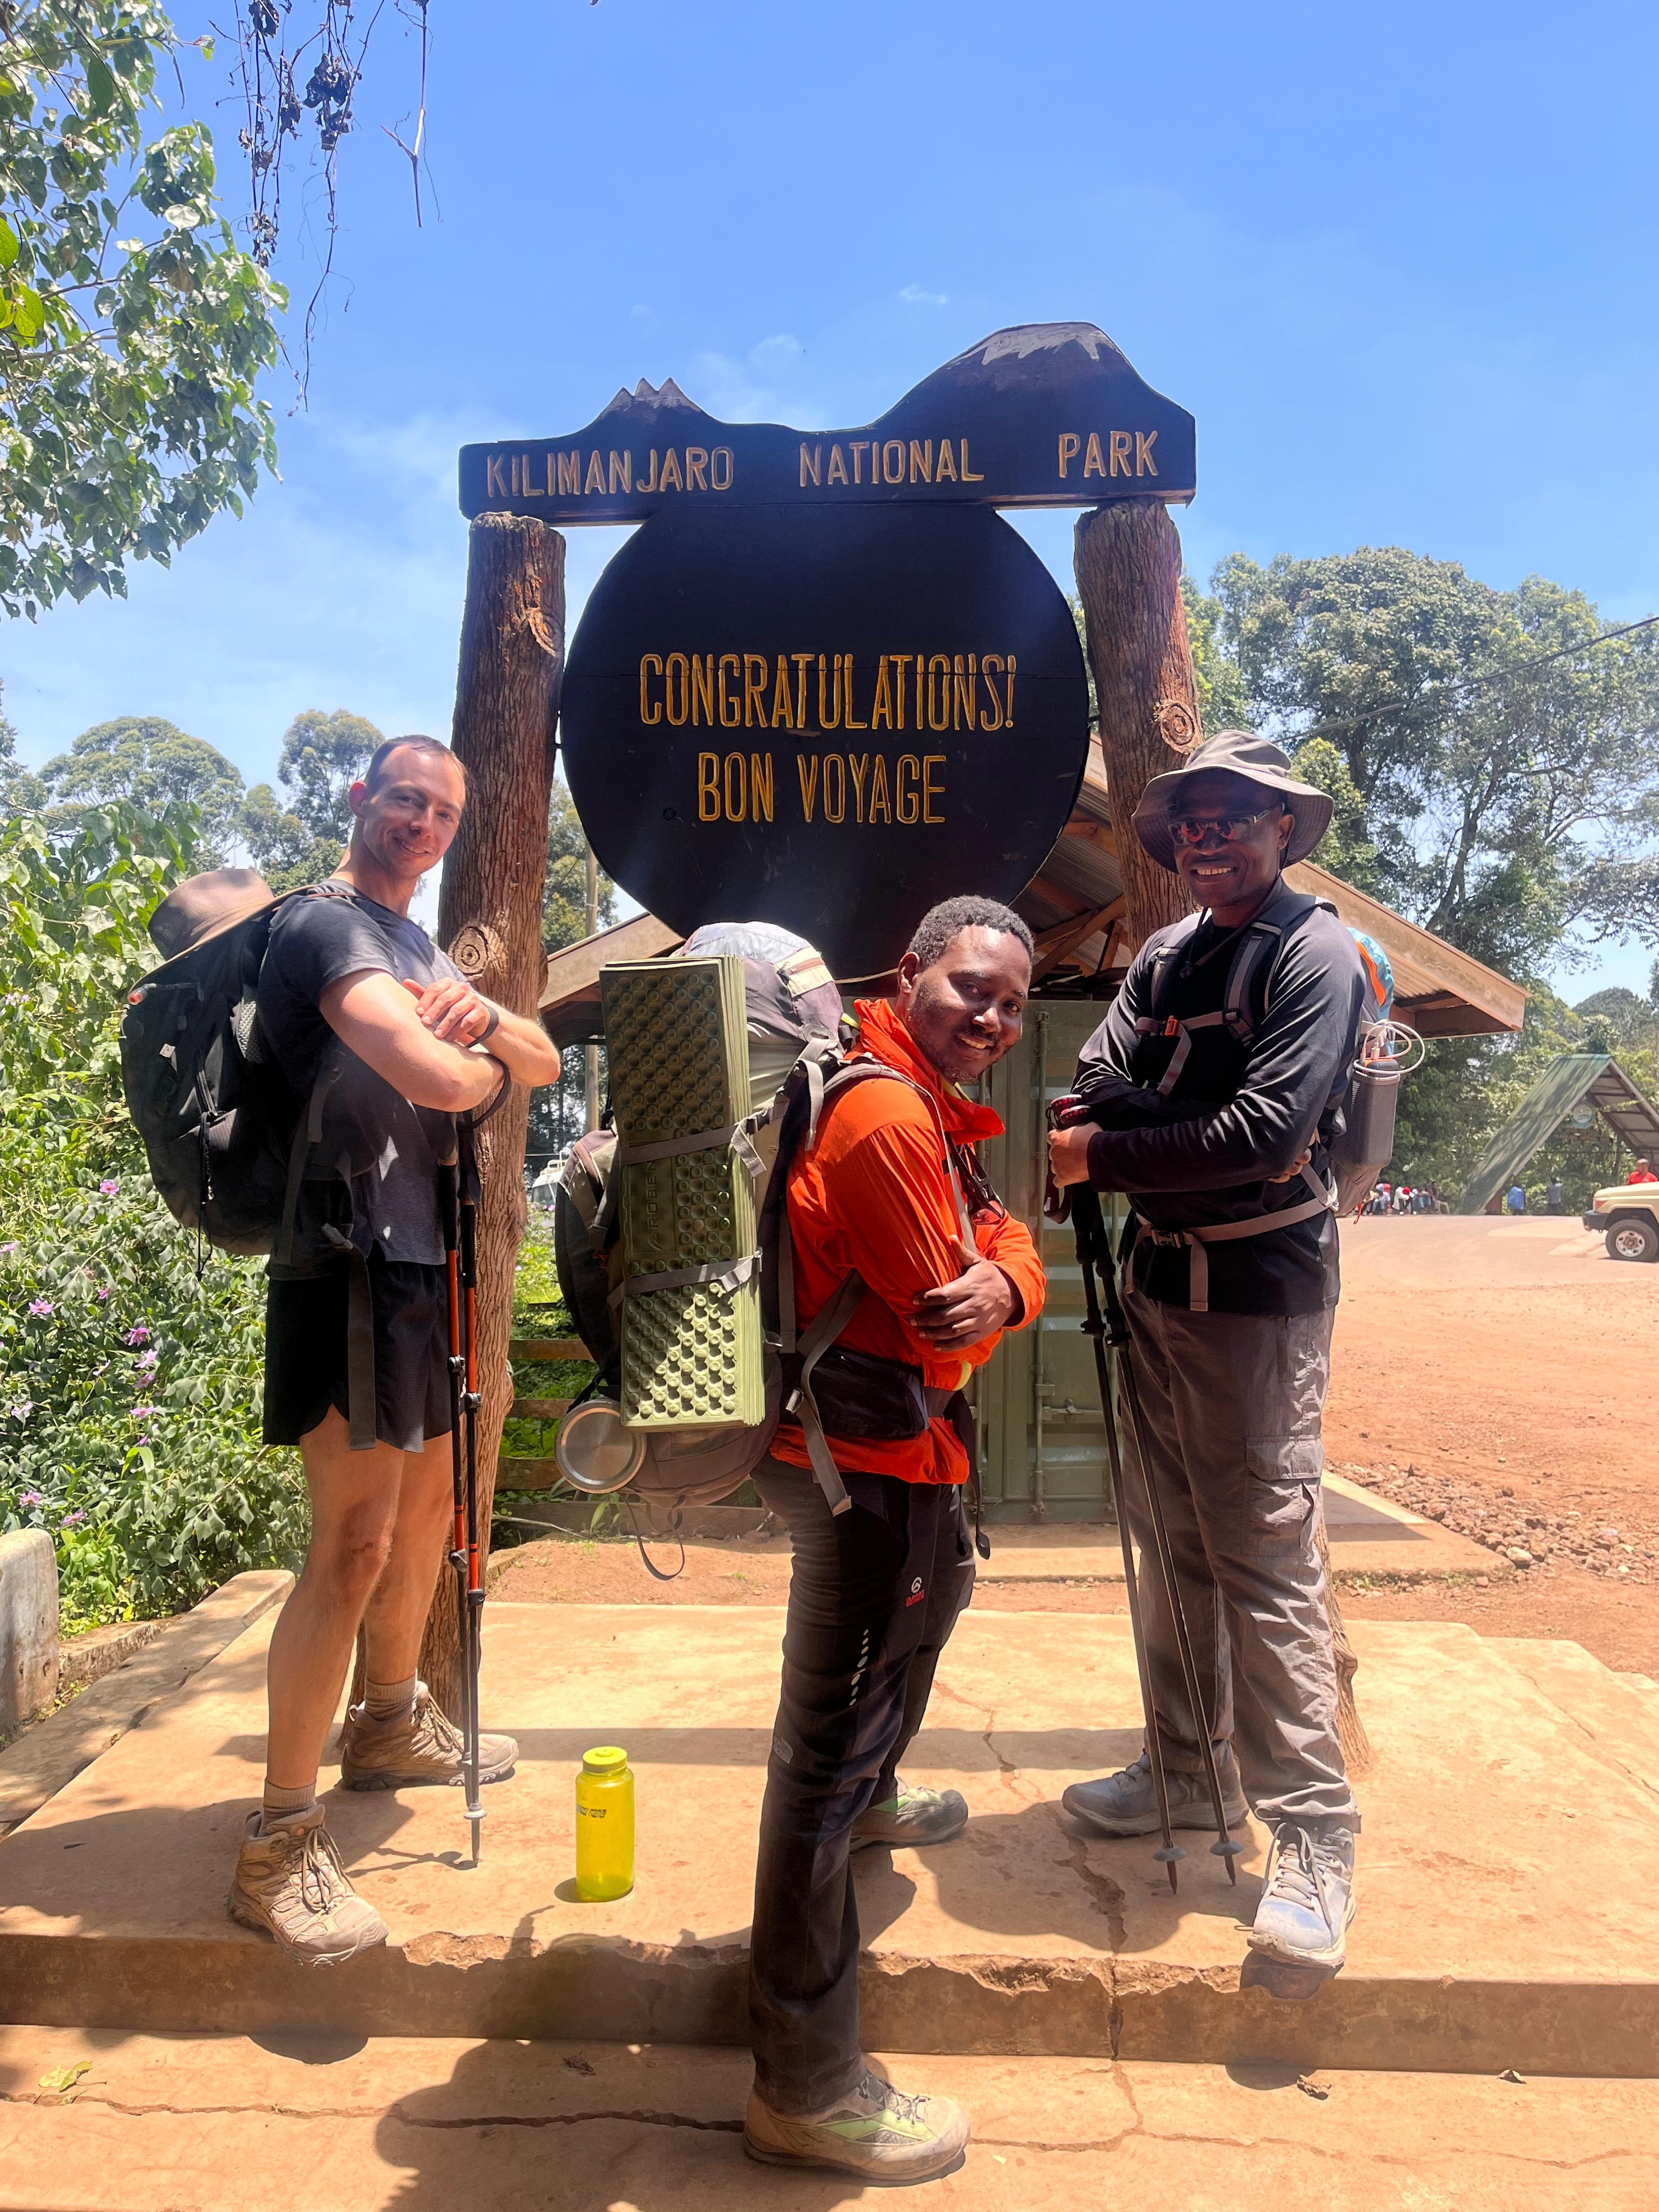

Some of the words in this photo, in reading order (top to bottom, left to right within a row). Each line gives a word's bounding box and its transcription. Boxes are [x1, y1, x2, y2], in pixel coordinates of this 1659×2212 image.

[487, 447, 734, 497] KILIMANJARO
[799, 438, 984, 487] NATIONAL
[1058, 430, 1159, 479] PARK
[640, 653, 1017, 731] CONGRATULATIONS!
[698, 752, 774, 823] BON
[797, 753, 947, 825] VOYAGE
